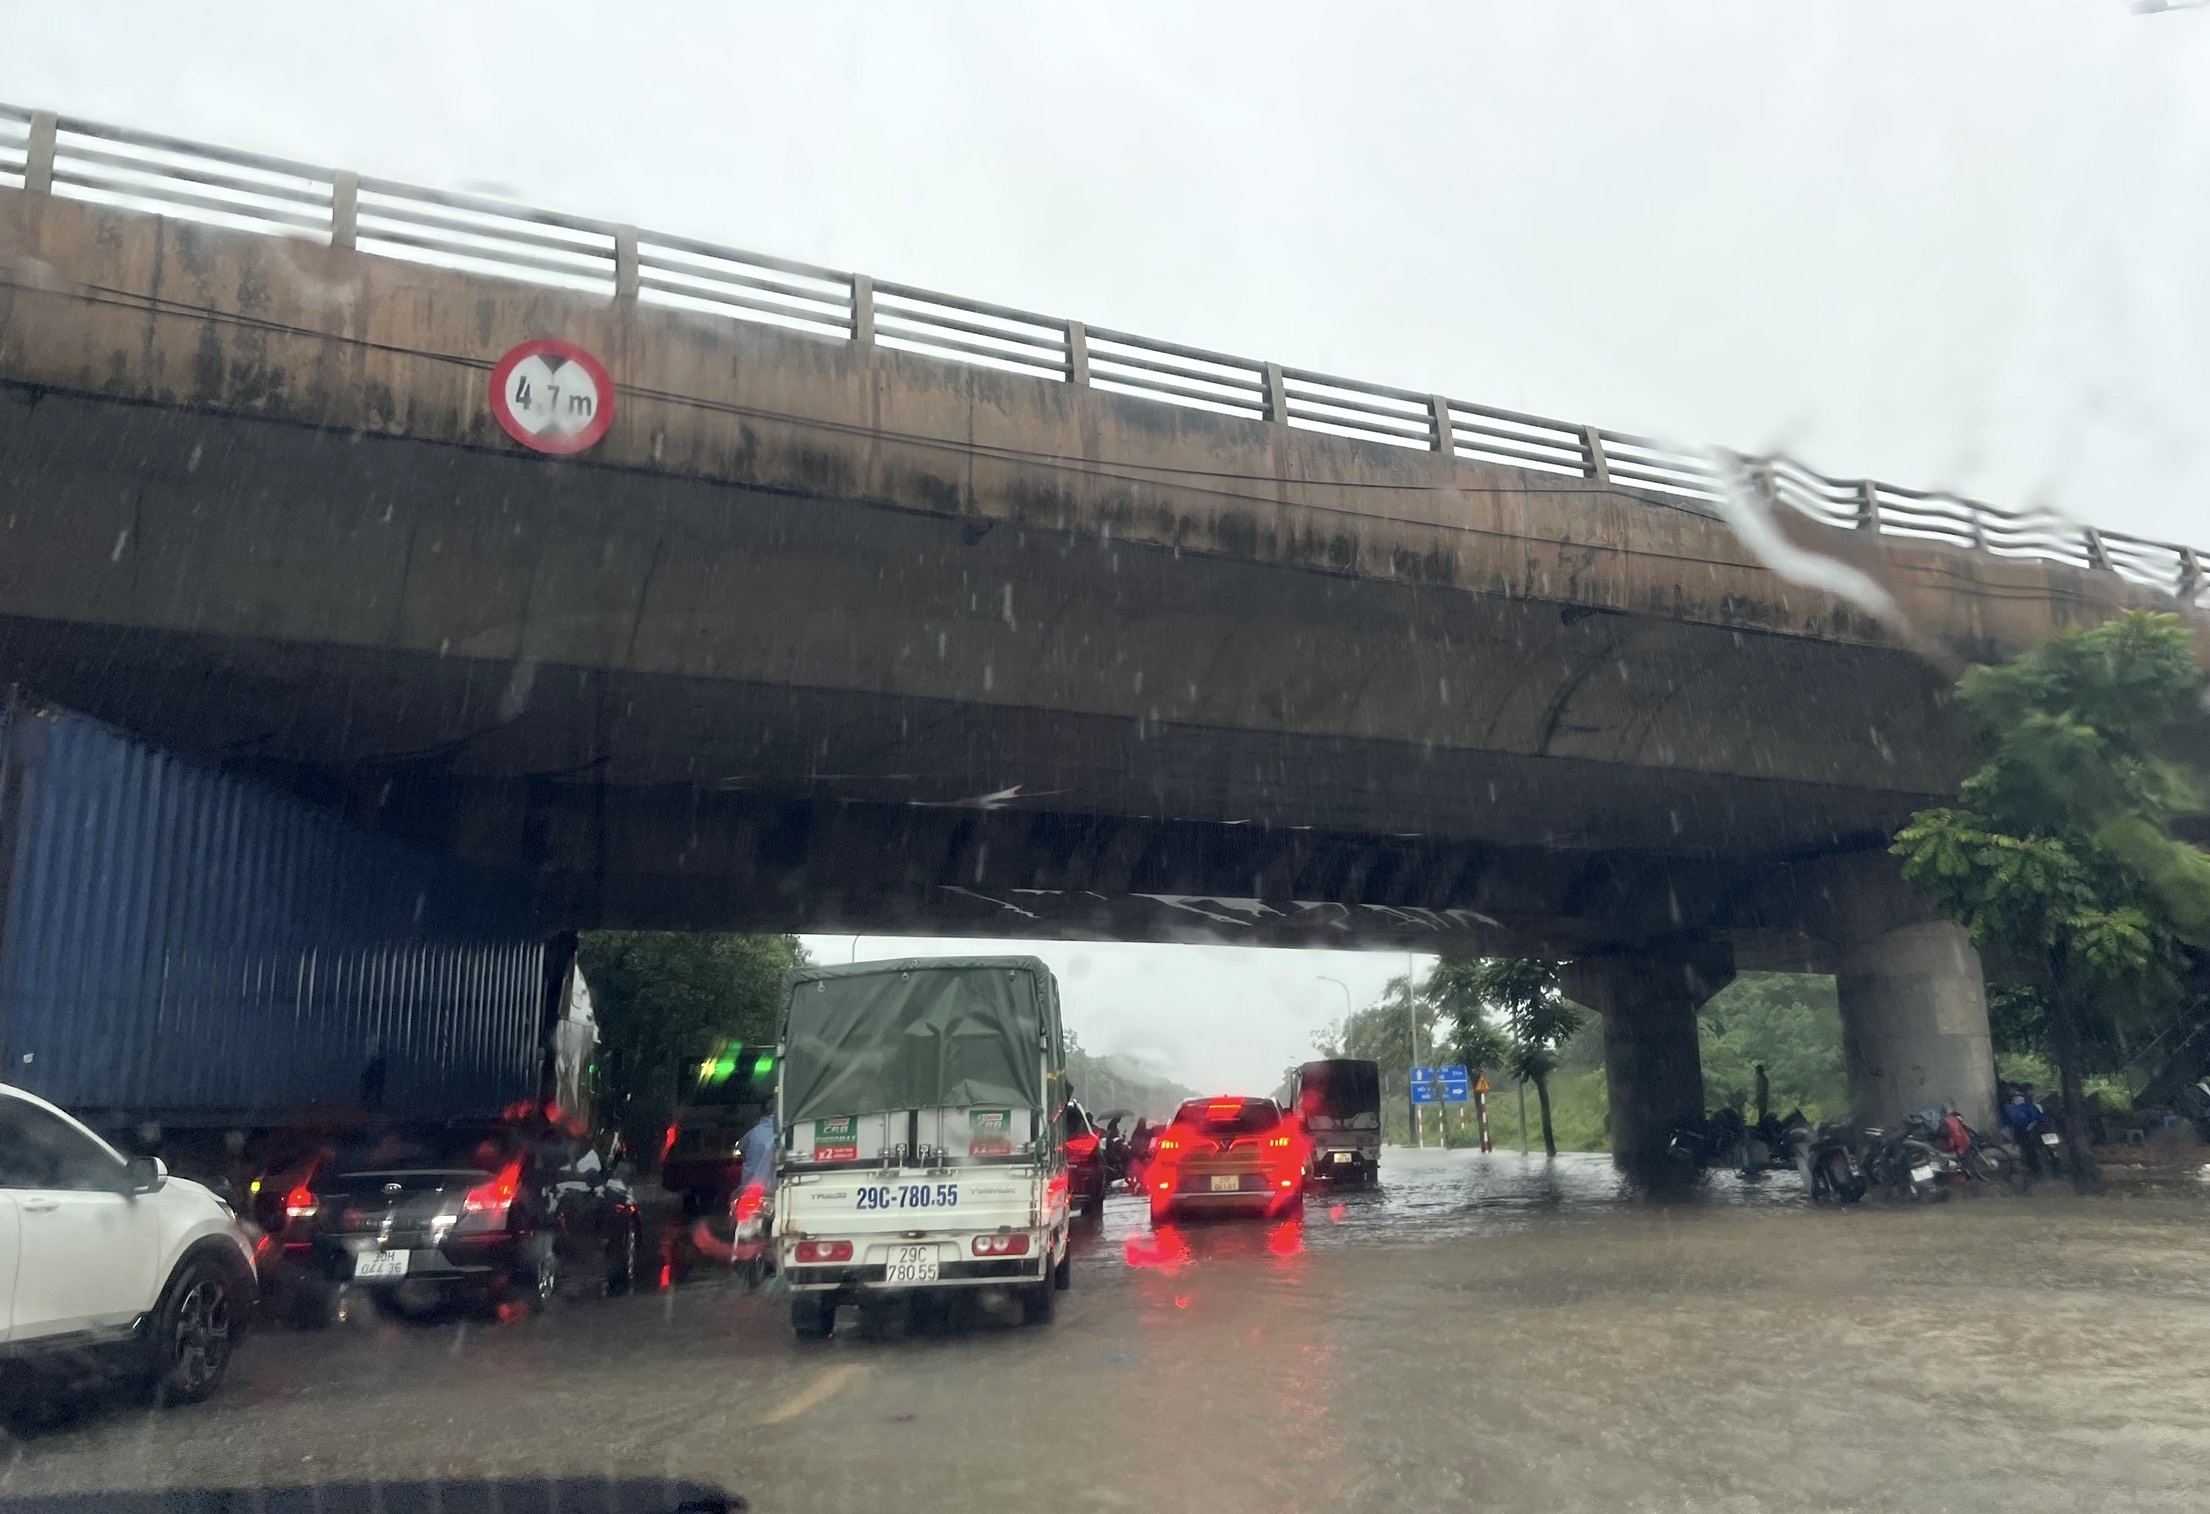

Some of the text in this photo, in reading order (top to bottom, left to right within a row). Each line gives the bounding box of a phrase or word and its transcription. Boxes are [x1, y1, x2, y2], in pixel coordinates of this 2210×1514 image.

[568, 394, 592, 416] m
[818, 1149, 833, 1160] x2
[856, 1184, 958, 1210] 29C-780.55
[899, 1246, 926, 1263] 29C
[888, 1263, 936, 1282] 780.55
